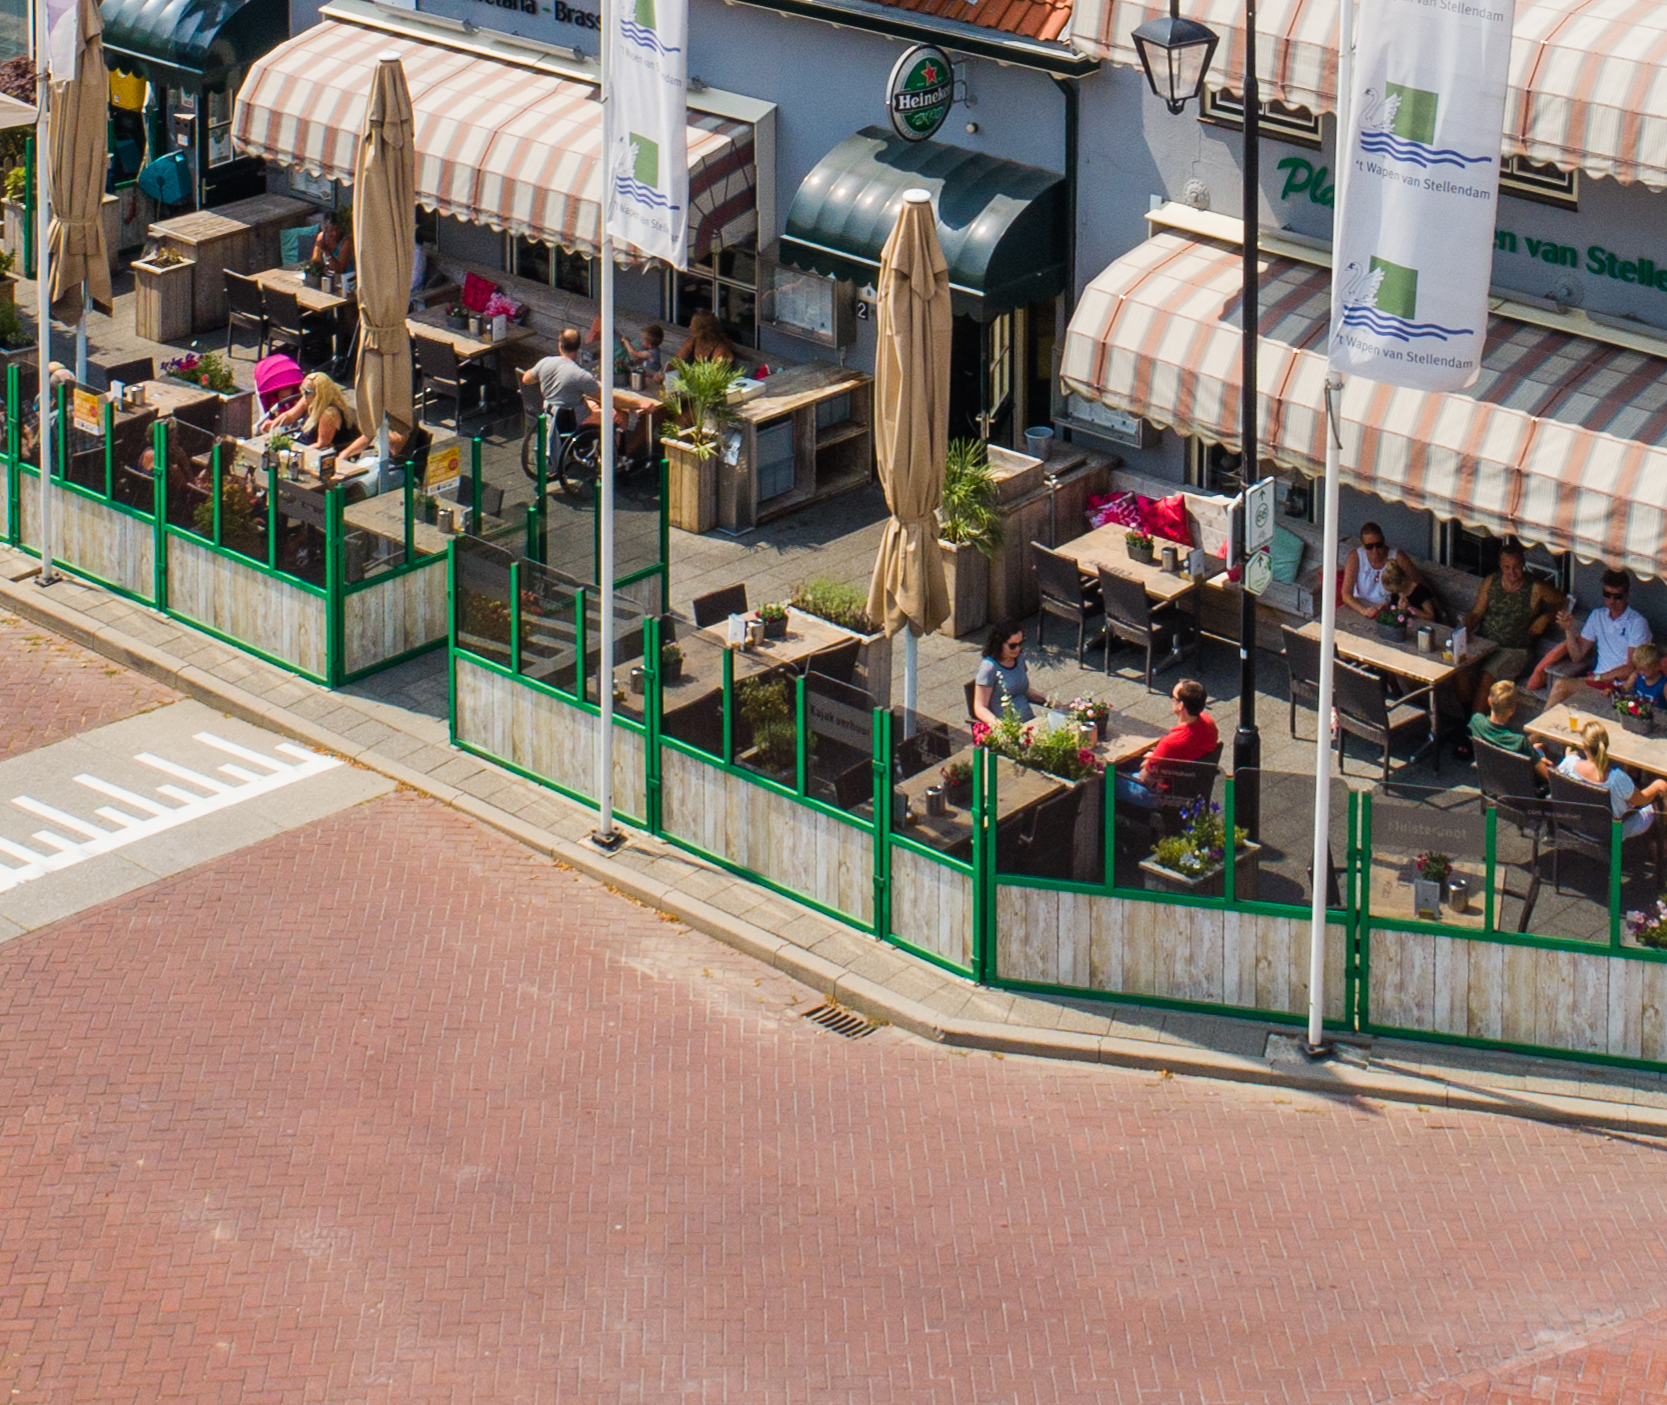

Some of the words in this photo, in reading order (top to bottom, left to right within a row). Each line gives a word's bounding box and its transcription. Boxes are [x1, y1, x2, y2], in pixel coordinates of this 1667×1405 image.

[554, 0, 601, 32] Brass
[1277, 157, 1333, 210] Pla
[1366, 161, 1400, 181] Wapen
[1401, 175, 1421, 188] van
[1423, 178, 1491, 200] Stellendam
[1523, 234, 1578, 269] van
[858, 302, 867, 319] 2
[1346, 334, 1380, 356] Wapen
[1382, 348, 1403, 361] van
[1406, 351, 1474, 369] Stellendam
